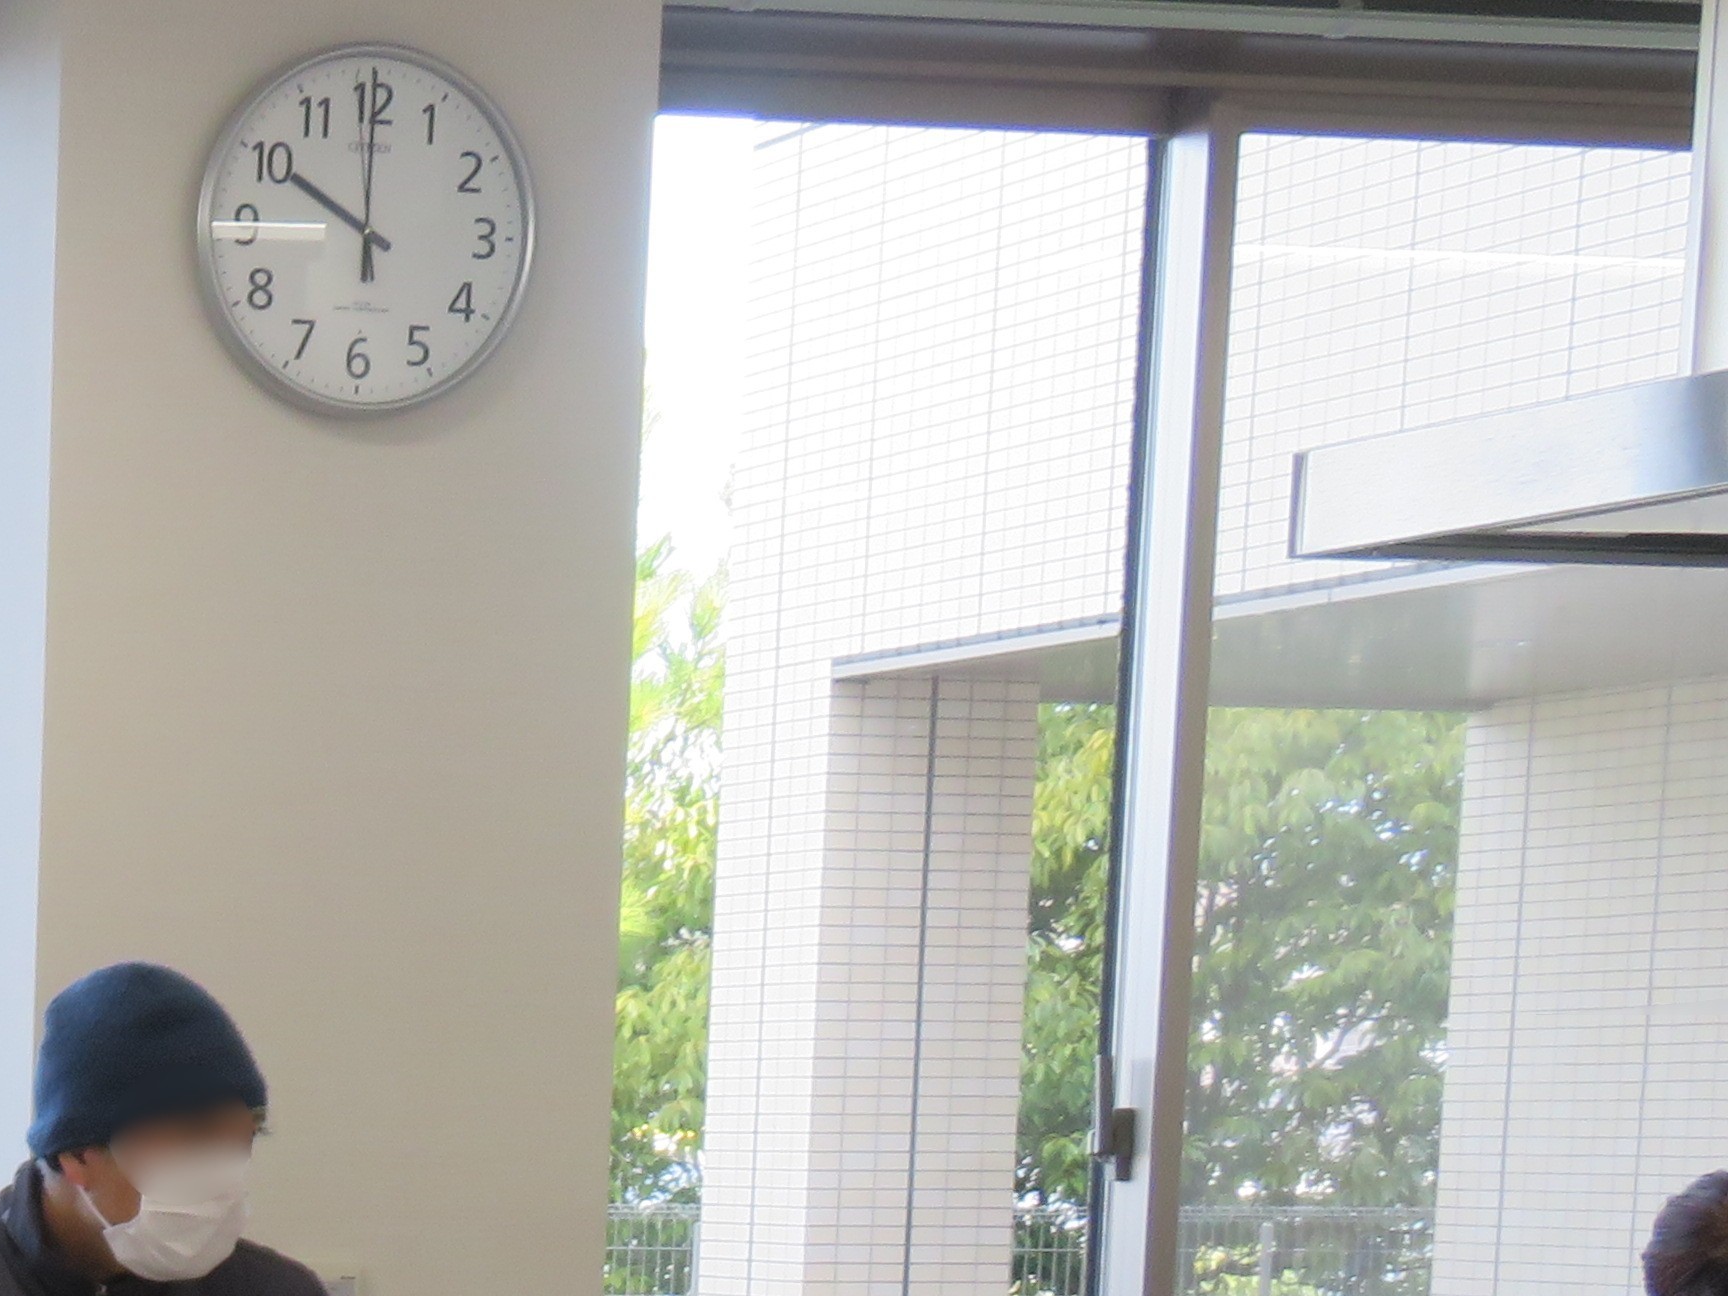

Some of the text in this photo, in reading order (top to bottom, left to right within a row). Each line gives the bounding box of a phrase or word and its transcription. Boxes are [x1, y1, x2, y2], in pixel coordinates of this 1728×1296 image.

[299, 97, 331, 139] 11
[353, 82, 393, 125] 12
[422, 103, 437, 145] 1
[251, 141, 293, 183] 10
[457, 151, 483, 193] 2
[472, 217, 497, 259] 3
[247, 268, 274, 310] 8
[448, 282, 475, 322] 4
[291, 319, 315, 360] 7
[346, 337, 371, 379] 6
[406, 325, 431, 367] 5
